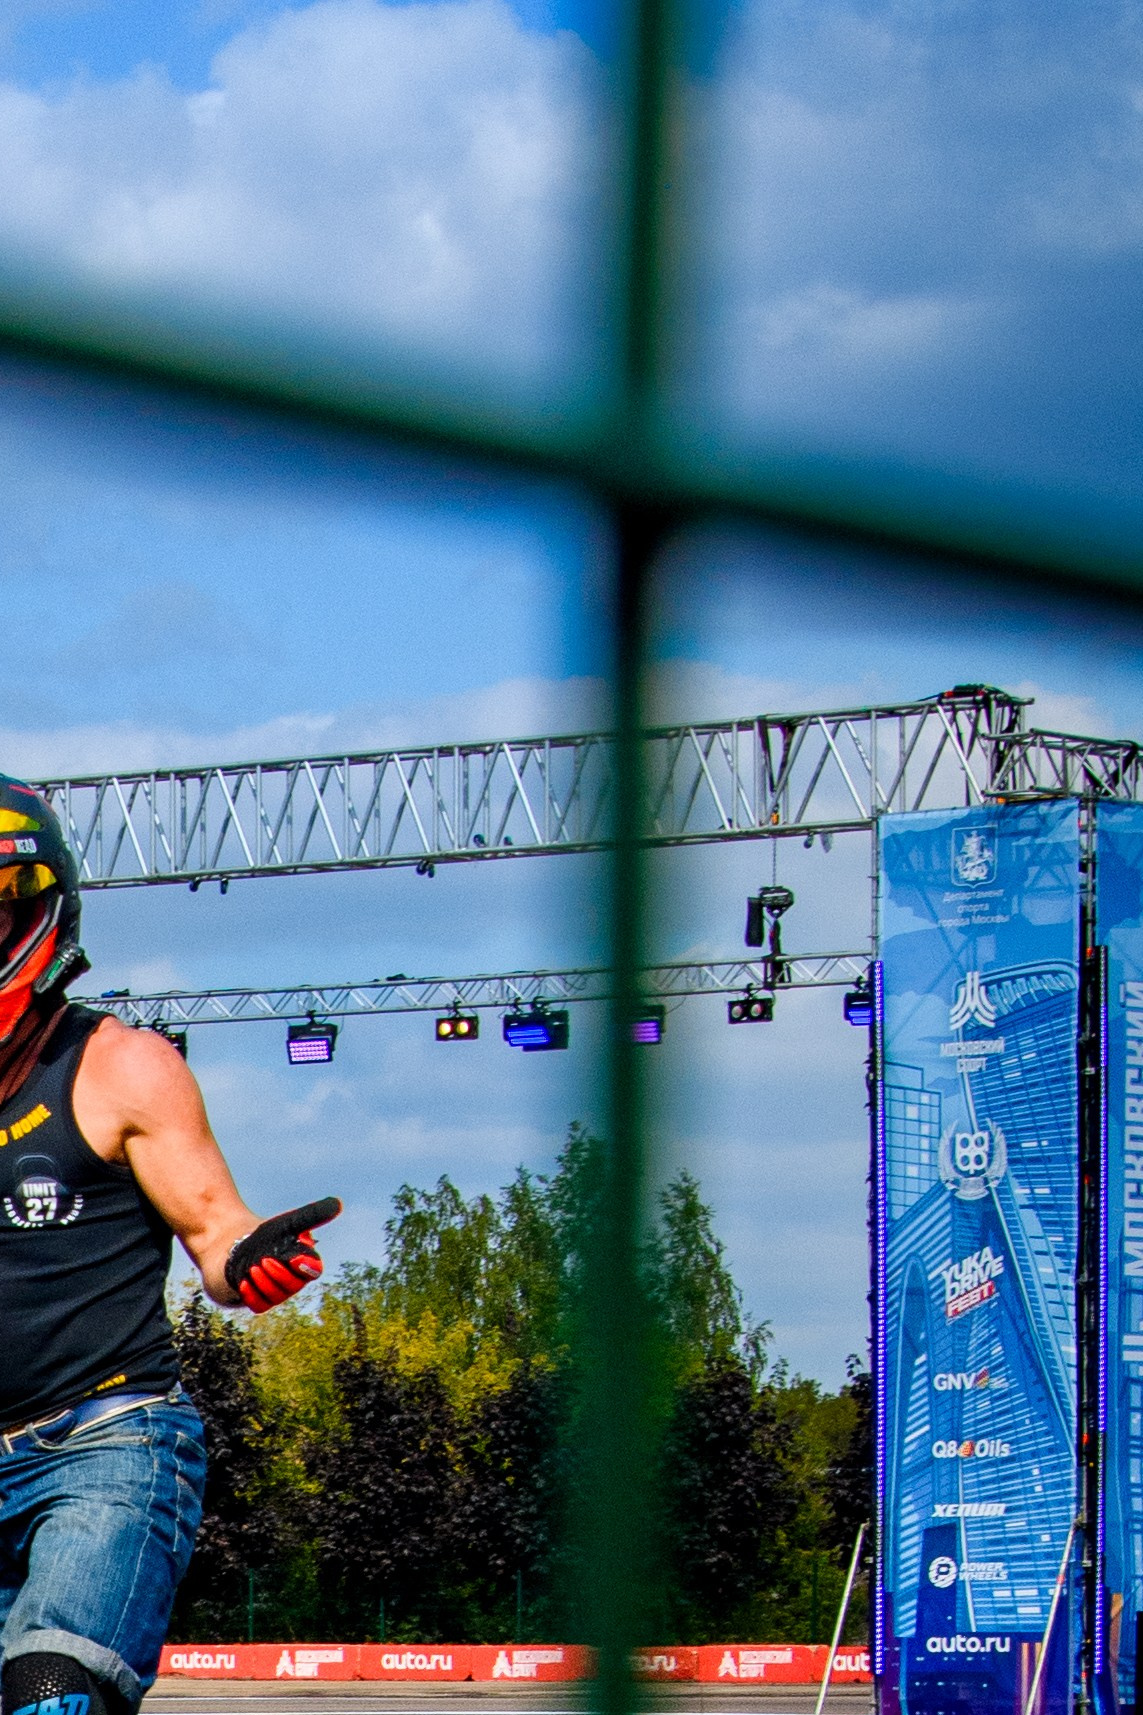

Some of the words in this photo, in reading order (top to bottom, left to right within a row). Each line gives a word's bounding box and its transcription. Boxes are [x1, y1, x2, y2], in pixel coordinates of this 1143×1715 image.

[10, 1103, 52, 1140] HOME
[22, 1183, 57, 1197] UNIT
[26, 1198, 58, 1221] 27
[945, 1255, 1004, 1302] DRIVE
[933, 1373, 977, 1391] GNV
[932, 1440, 958, 1458] Q8
[974, 1439, 1010, 1458] Oils
[959, 1571, 1008, 1581] WHEELS
[960, 1562, 1004, 1572] POWER
[926, 1634, 1011, 1653] auto.ru
[170, 1651, 235, 1670] auto.ru
[381, 1651, 453, 1671] auto.ru
